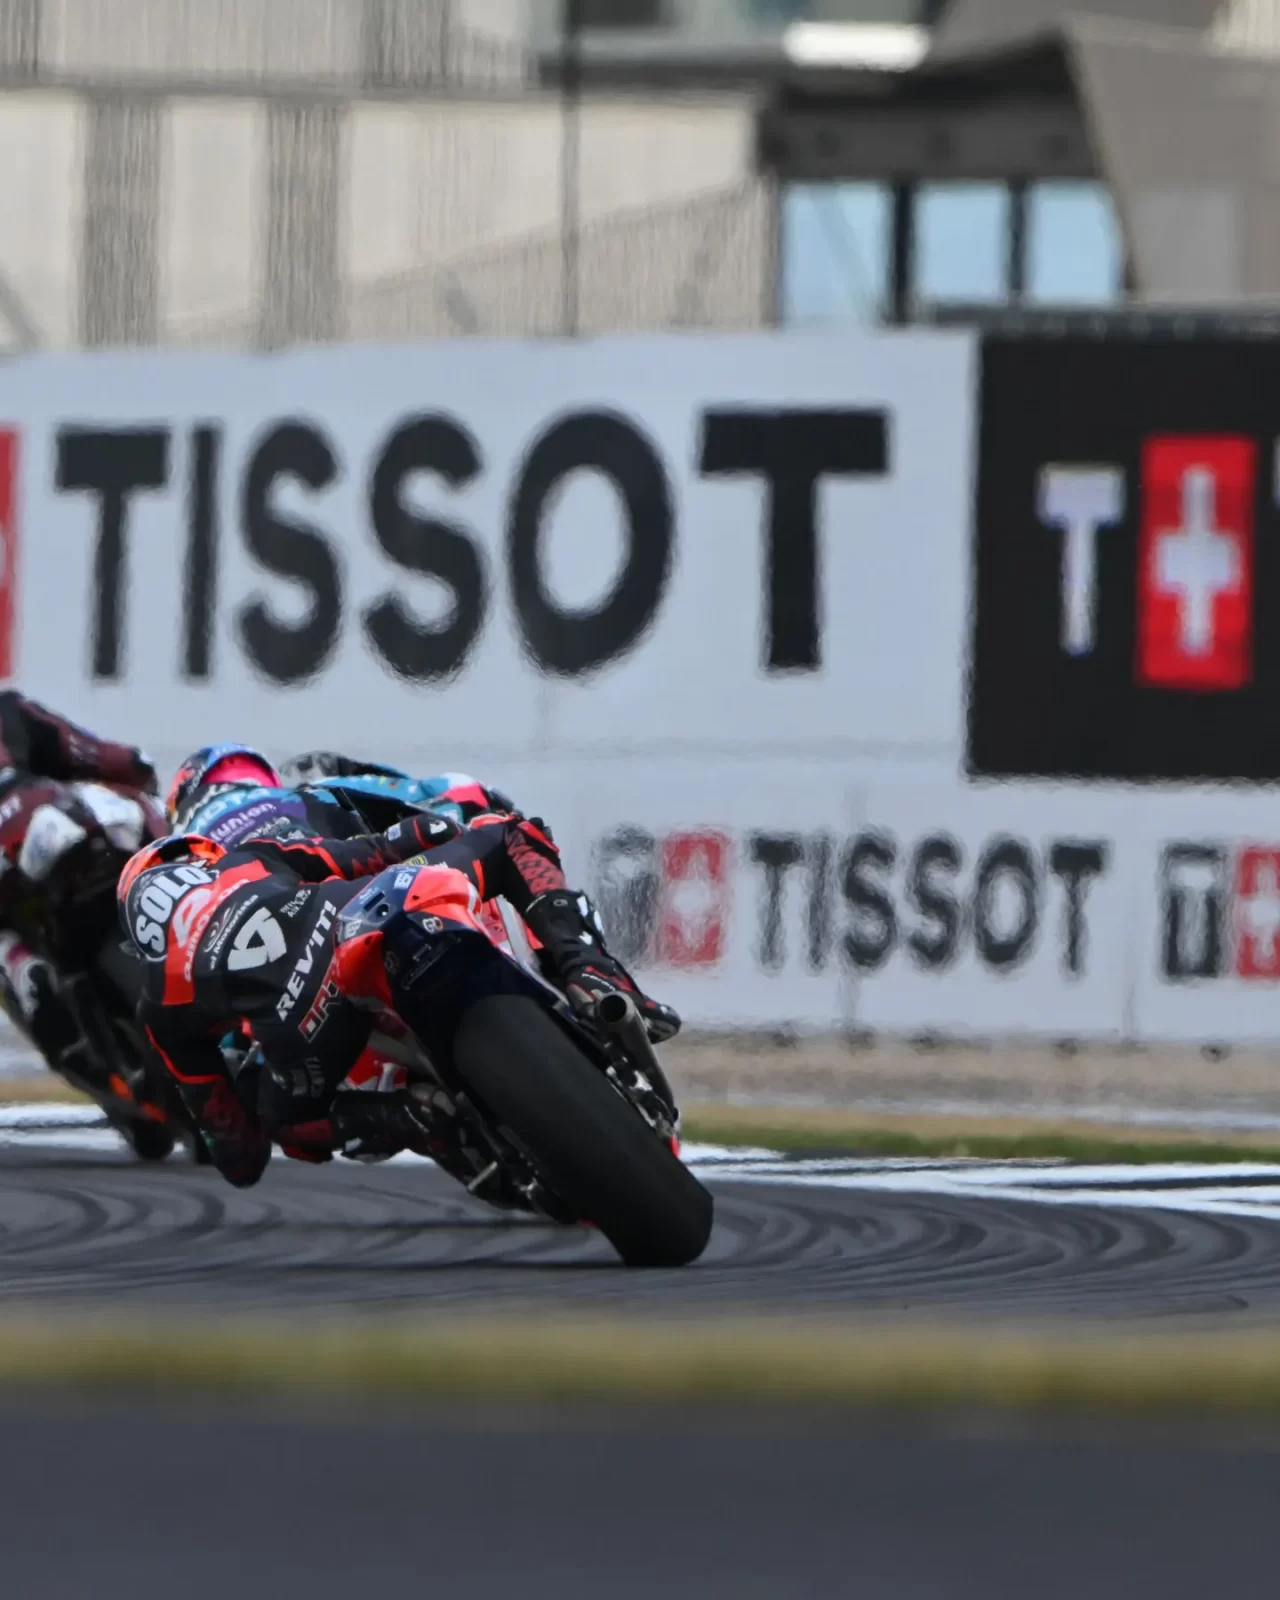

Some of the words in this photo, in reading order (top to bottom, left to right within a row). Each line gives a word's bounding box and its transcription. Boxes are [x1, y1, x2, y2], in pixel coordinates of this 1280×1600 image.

[53, 406, 892, 688] TISSOT
[135, 866, 213, 953] SOLO
[275, 899, 338, 1023] REV'IT!
[748, 832, 1108, 975] TISSOT
